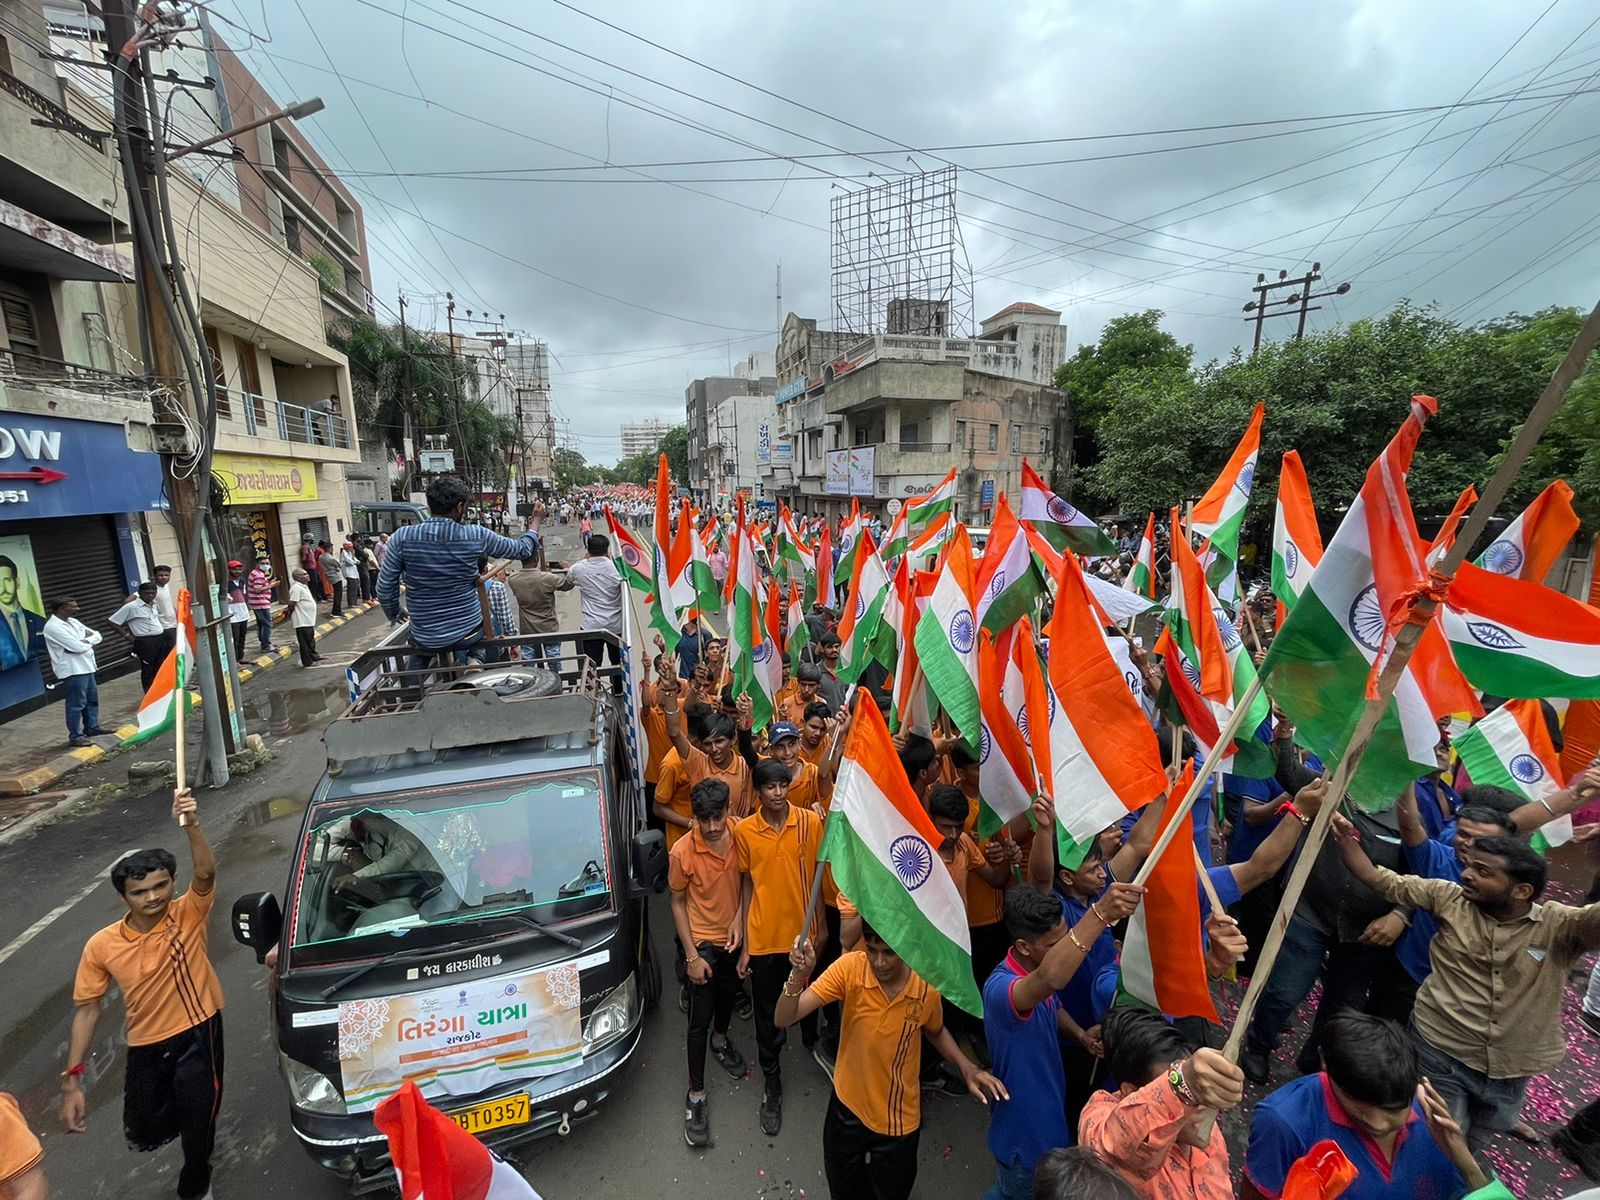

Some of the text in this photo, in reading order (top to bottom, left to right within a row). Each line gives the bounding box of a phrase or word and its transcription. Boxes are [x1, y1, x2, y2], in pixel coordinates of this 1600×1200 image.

[423, 953, 491, 976] જય દ્વારકાધીશ
[397, 1003, 527, 1042] તિરંગા યાત્રા
[446, 1030, 482, 1045] રાજકોટ
